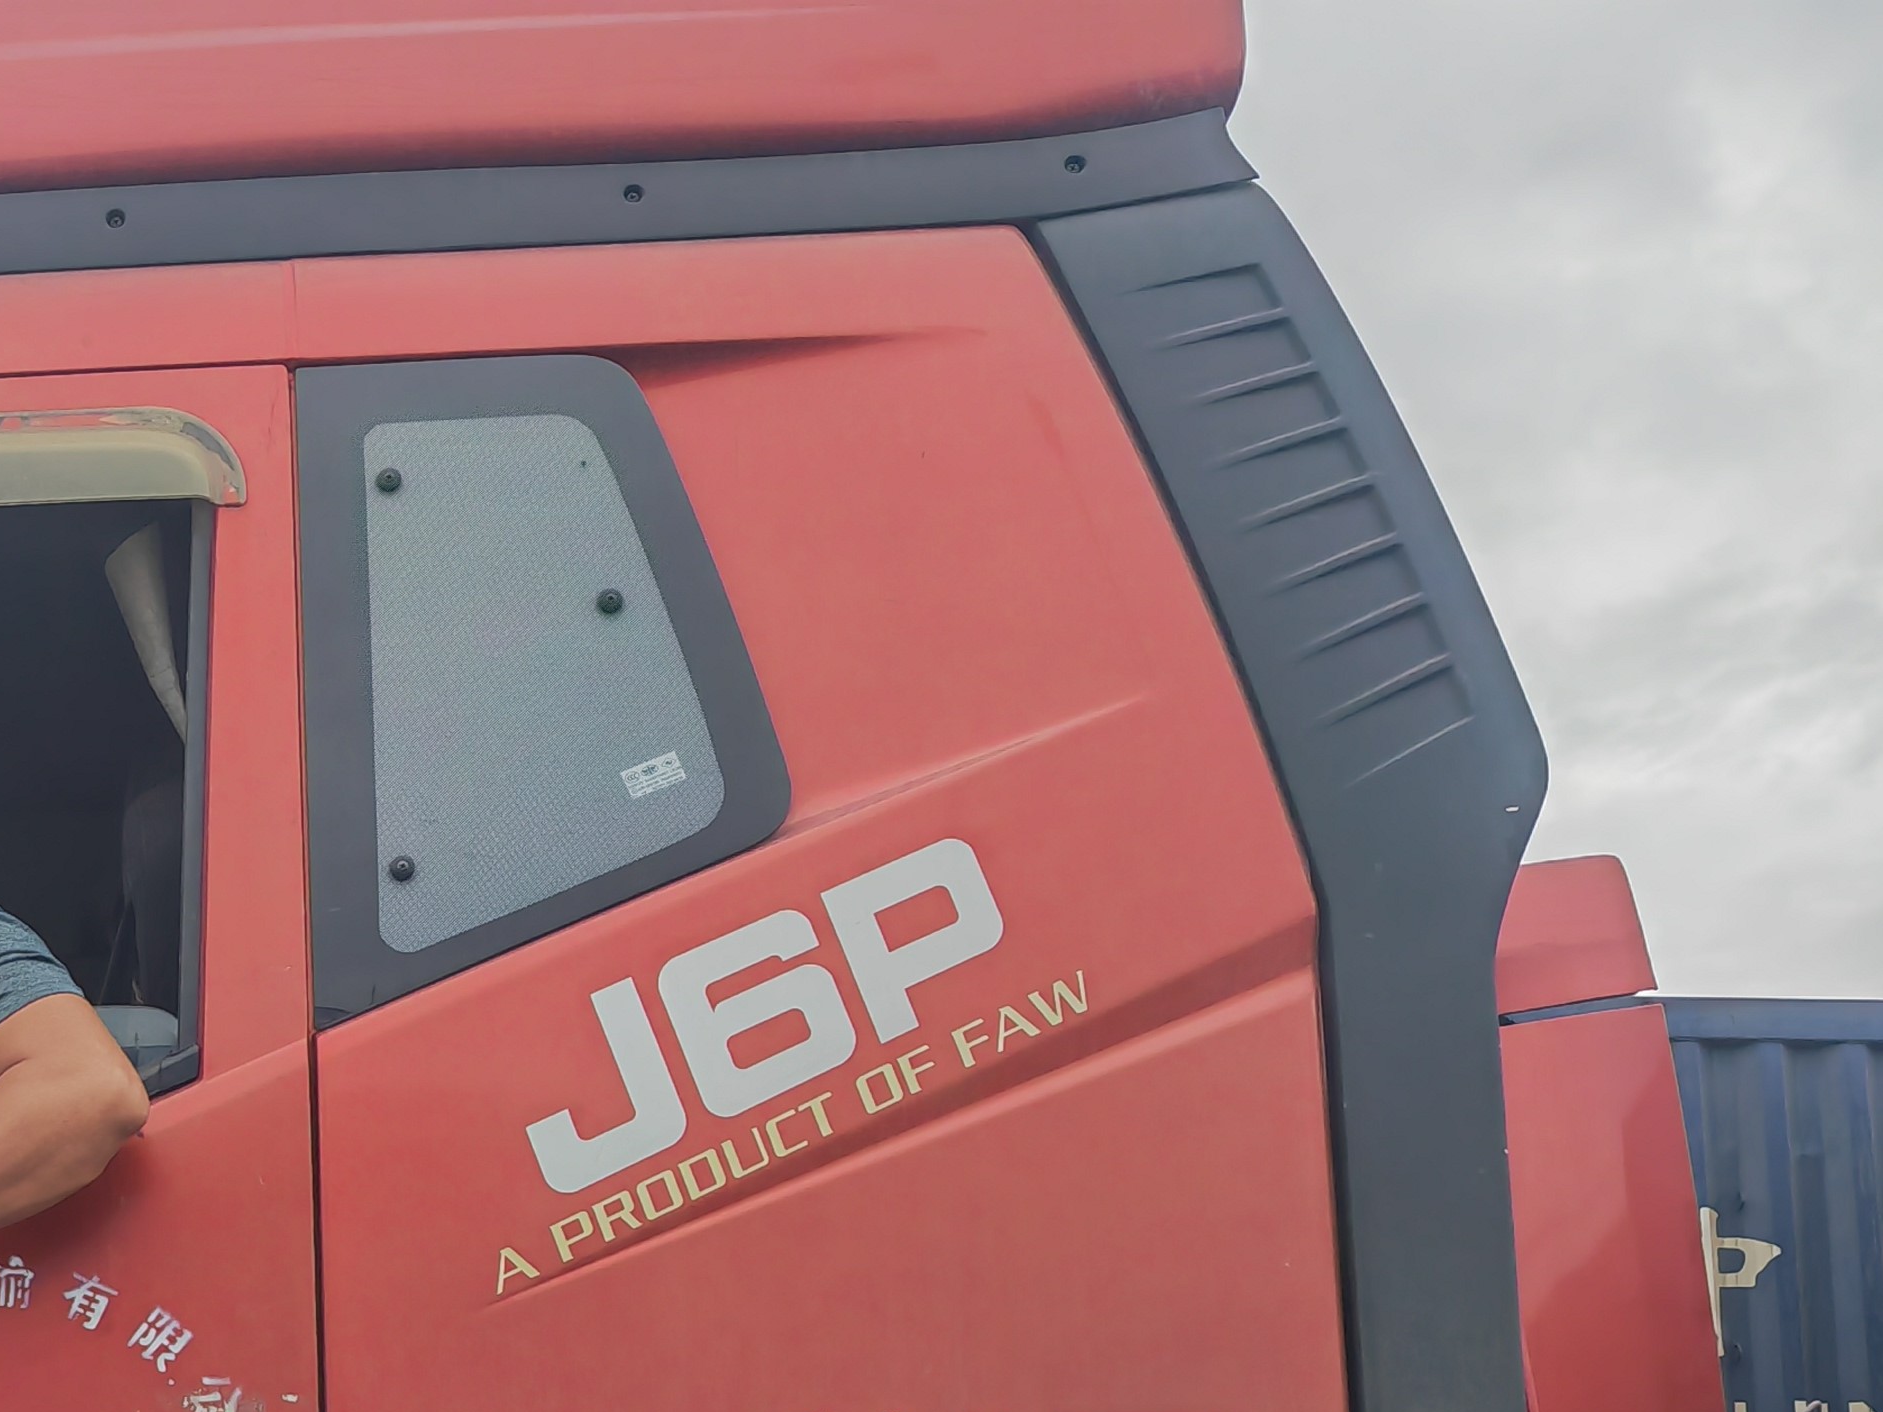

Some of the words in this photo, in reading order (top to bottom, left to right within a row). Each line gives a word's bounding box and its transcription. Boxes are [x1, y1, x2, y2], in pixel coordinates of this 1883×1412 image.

[495, 1248, 540, 1295] A
[549, 1092, 834, 1263] PRODUCT
[856, 1045, 935, 1115] OF
[952, 970, 1090, 1068] FAW
[526, 838, 1004, 1193] J6P
